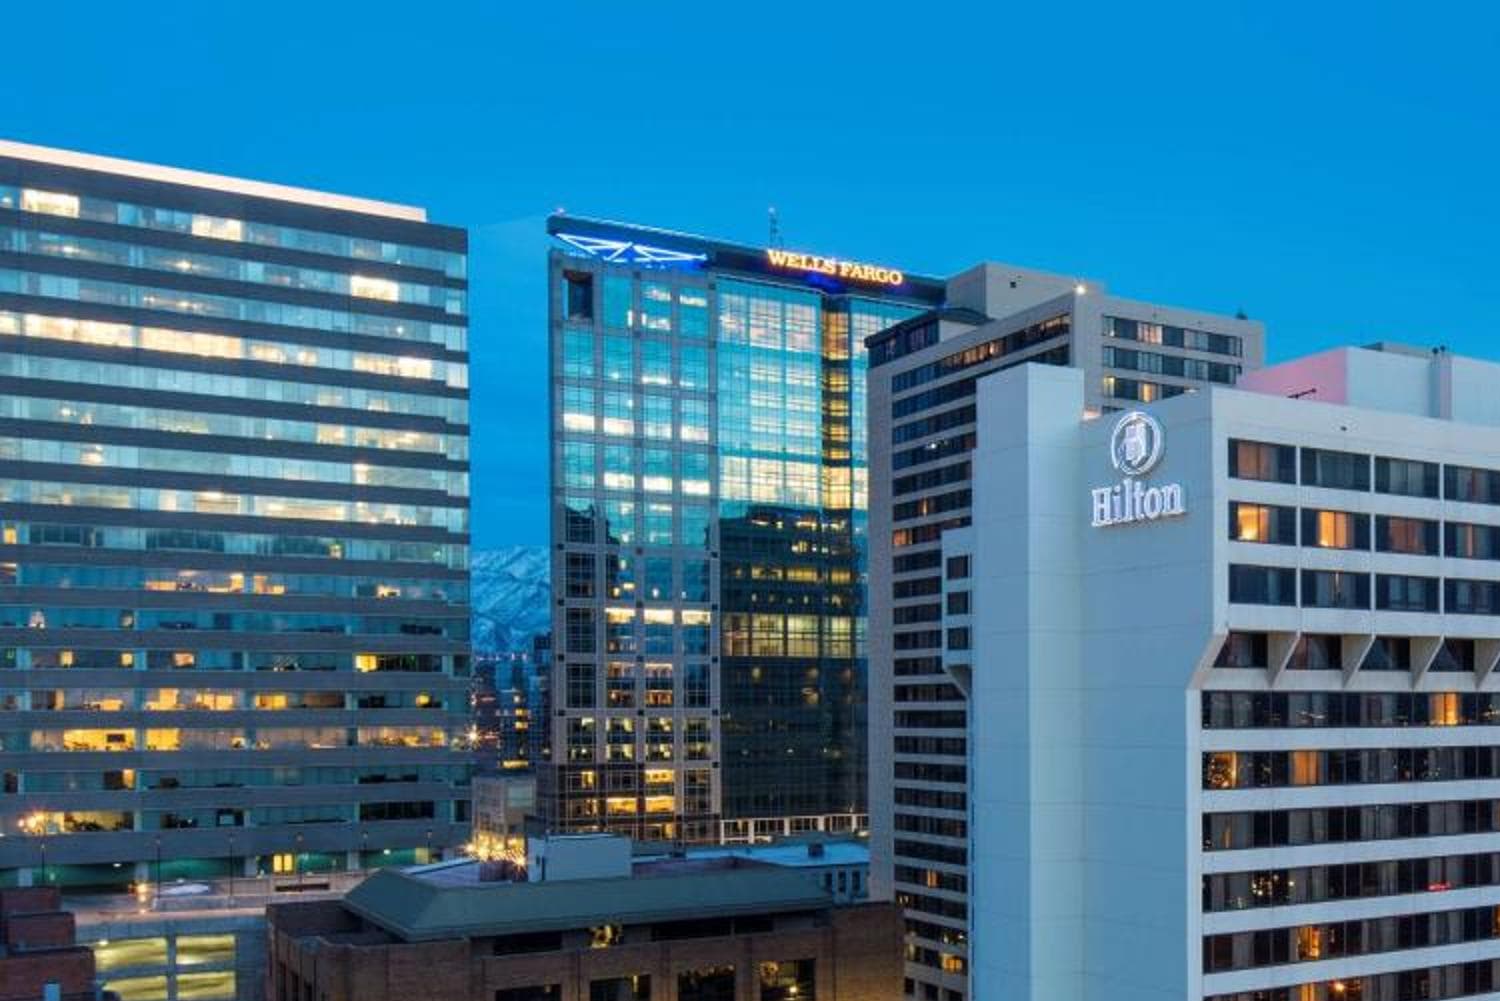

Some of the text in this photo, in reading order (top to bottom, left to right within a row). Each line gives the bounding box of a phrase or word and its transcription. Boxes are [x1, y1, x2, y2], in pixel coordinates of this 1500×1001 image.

[767, 250, 902, 285] WELLS FARGO
[1091, 479, 1184, 527] Hilton
